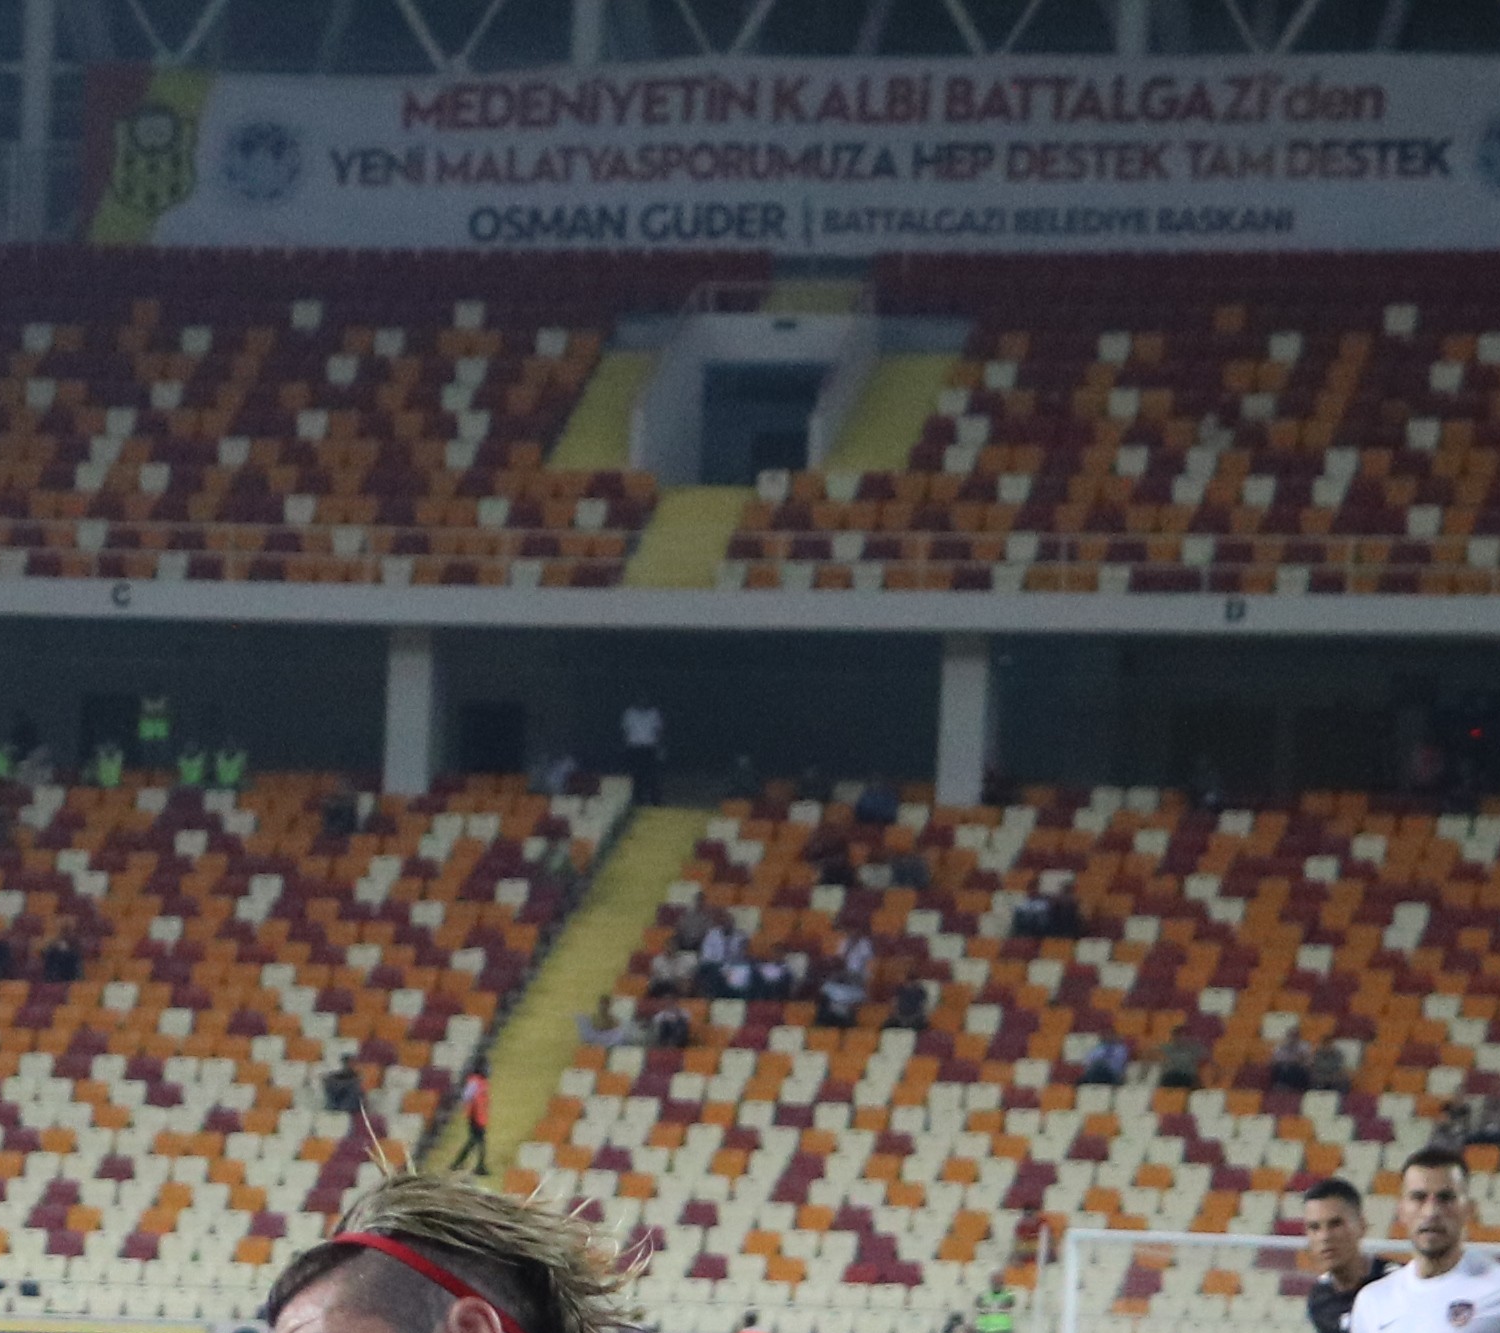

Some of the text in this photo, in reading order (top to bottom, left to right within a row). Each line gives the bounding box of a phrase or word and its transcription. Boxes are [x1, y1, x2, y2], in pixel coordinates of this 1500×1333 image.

[912, 142, 995, 181] HEP
[1006, 140, 1166, 182] DESTEK
[1189, 141, 1277, 180] TAM
[1290, 138, 1453, 180] DESTEK
[468, 204, 628, 244] OSMAN
